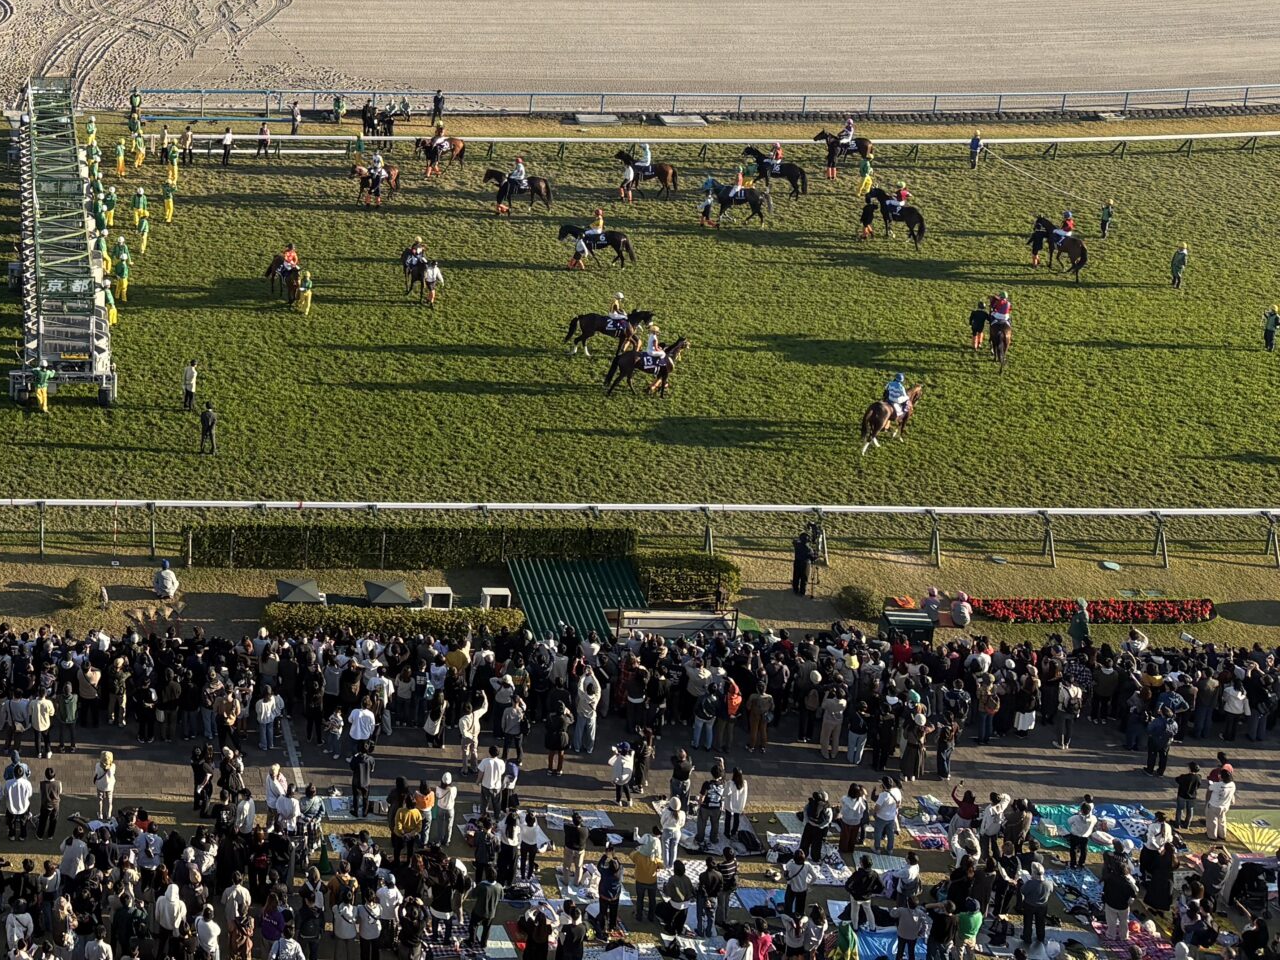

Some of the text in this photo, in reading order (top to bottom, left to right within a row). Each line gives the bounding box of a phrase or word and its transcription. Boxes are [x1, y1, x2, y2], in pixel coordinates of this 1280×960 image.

[47, 279, 90, 292] 京都
[606, 319, 614, 327] 2
[643, 356, 653, 366] 13
